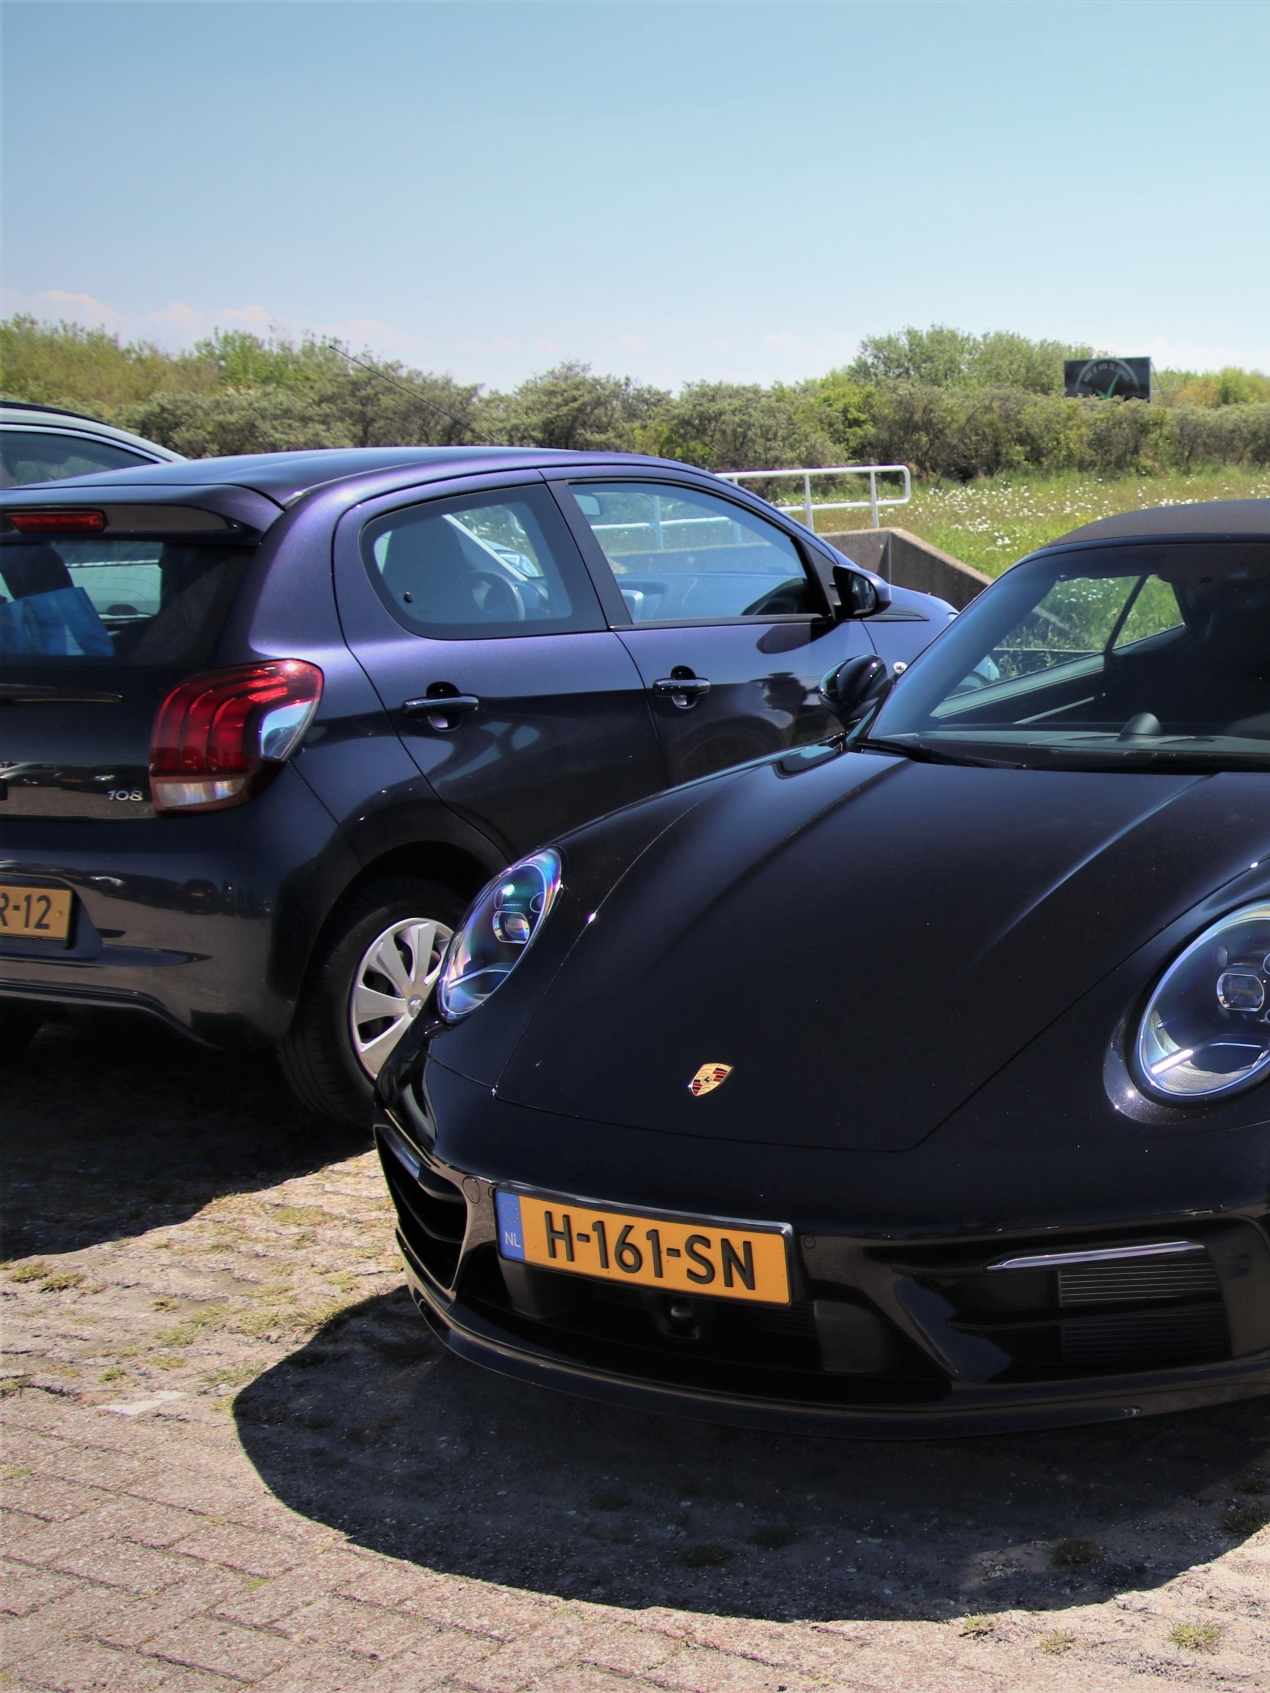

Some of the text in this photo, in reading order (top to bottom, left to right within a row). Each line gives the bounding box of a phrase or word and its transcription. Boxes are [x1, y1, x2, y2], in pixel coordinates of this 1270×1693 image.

[107, 790, 143, 801] 108
[504, 1231, 522, 1249] NL
[544, 1210, 756, 1291] H-161-SN
